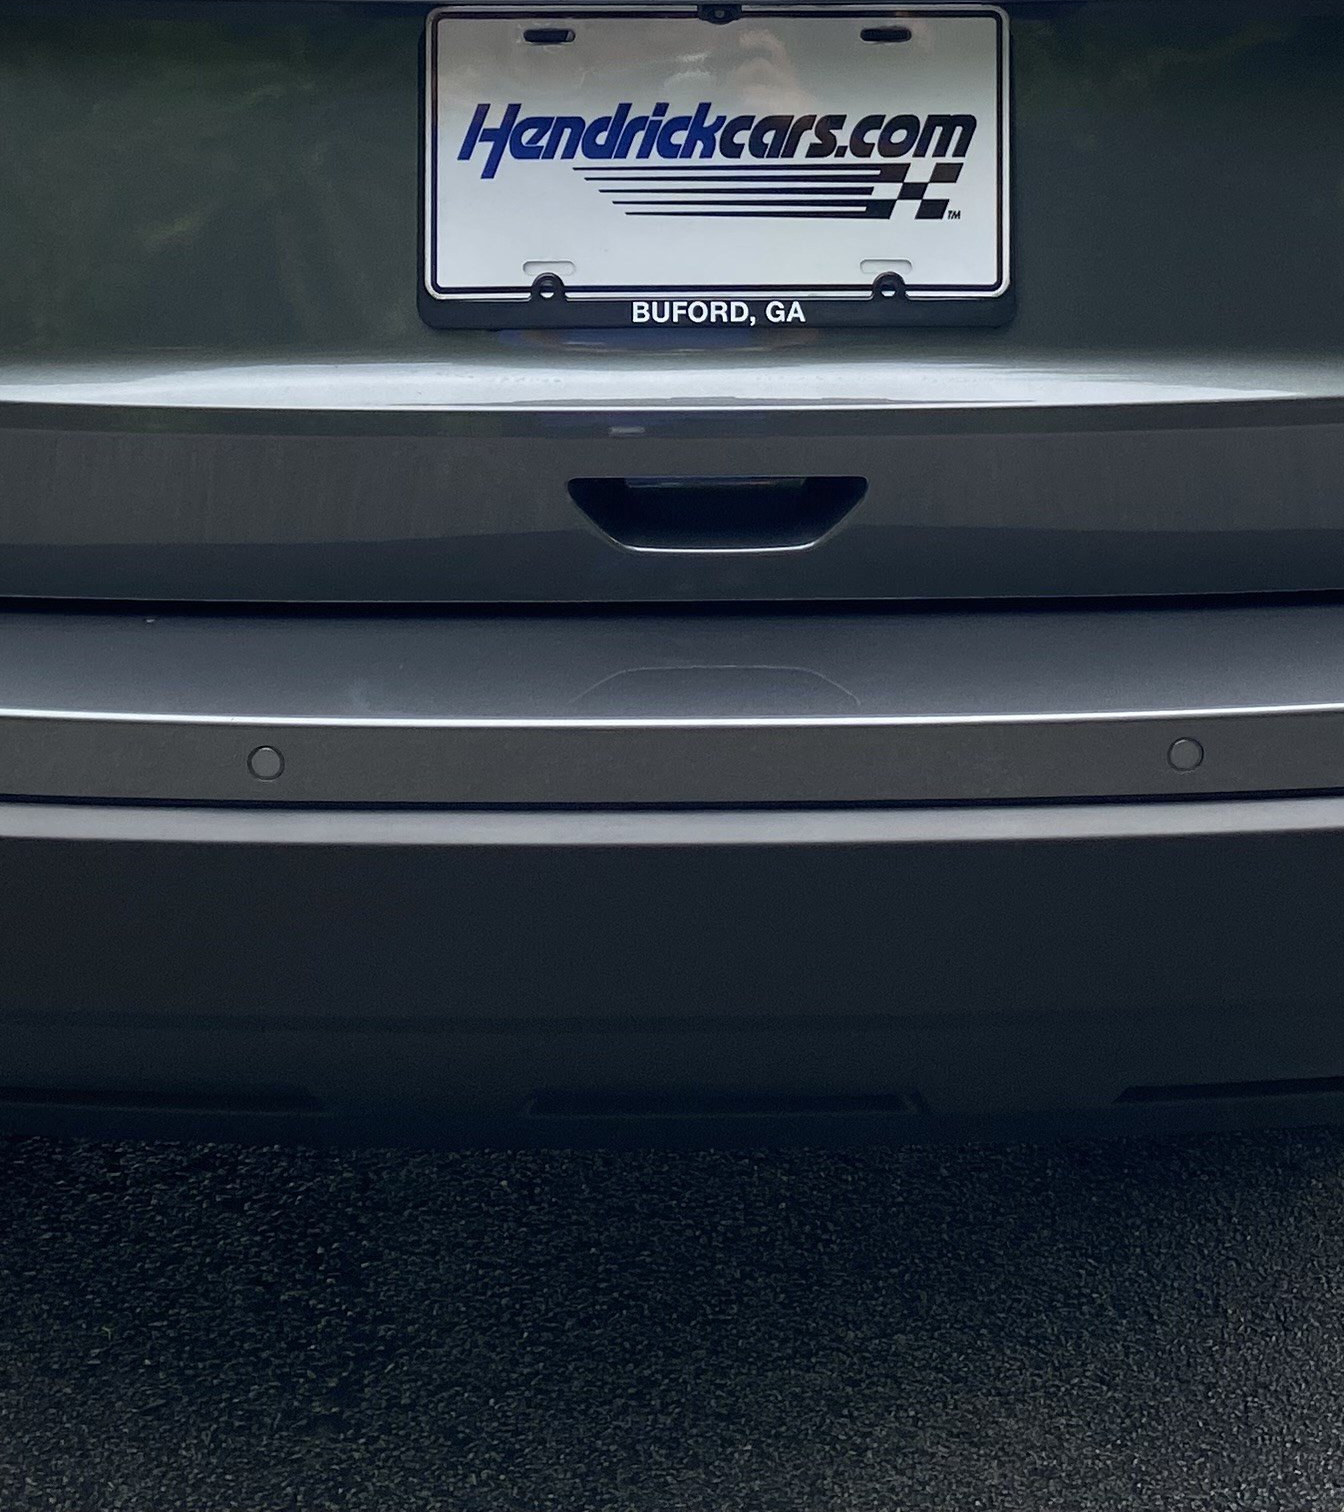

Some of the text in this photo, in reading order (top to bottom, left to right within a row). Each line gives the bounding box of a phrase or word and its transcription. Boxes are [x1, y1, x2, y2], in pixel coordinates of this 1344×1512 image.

[456, 102, 978, 180] Hendrickcars.com
[631, 300, 807, 327] BUFORD, GA
